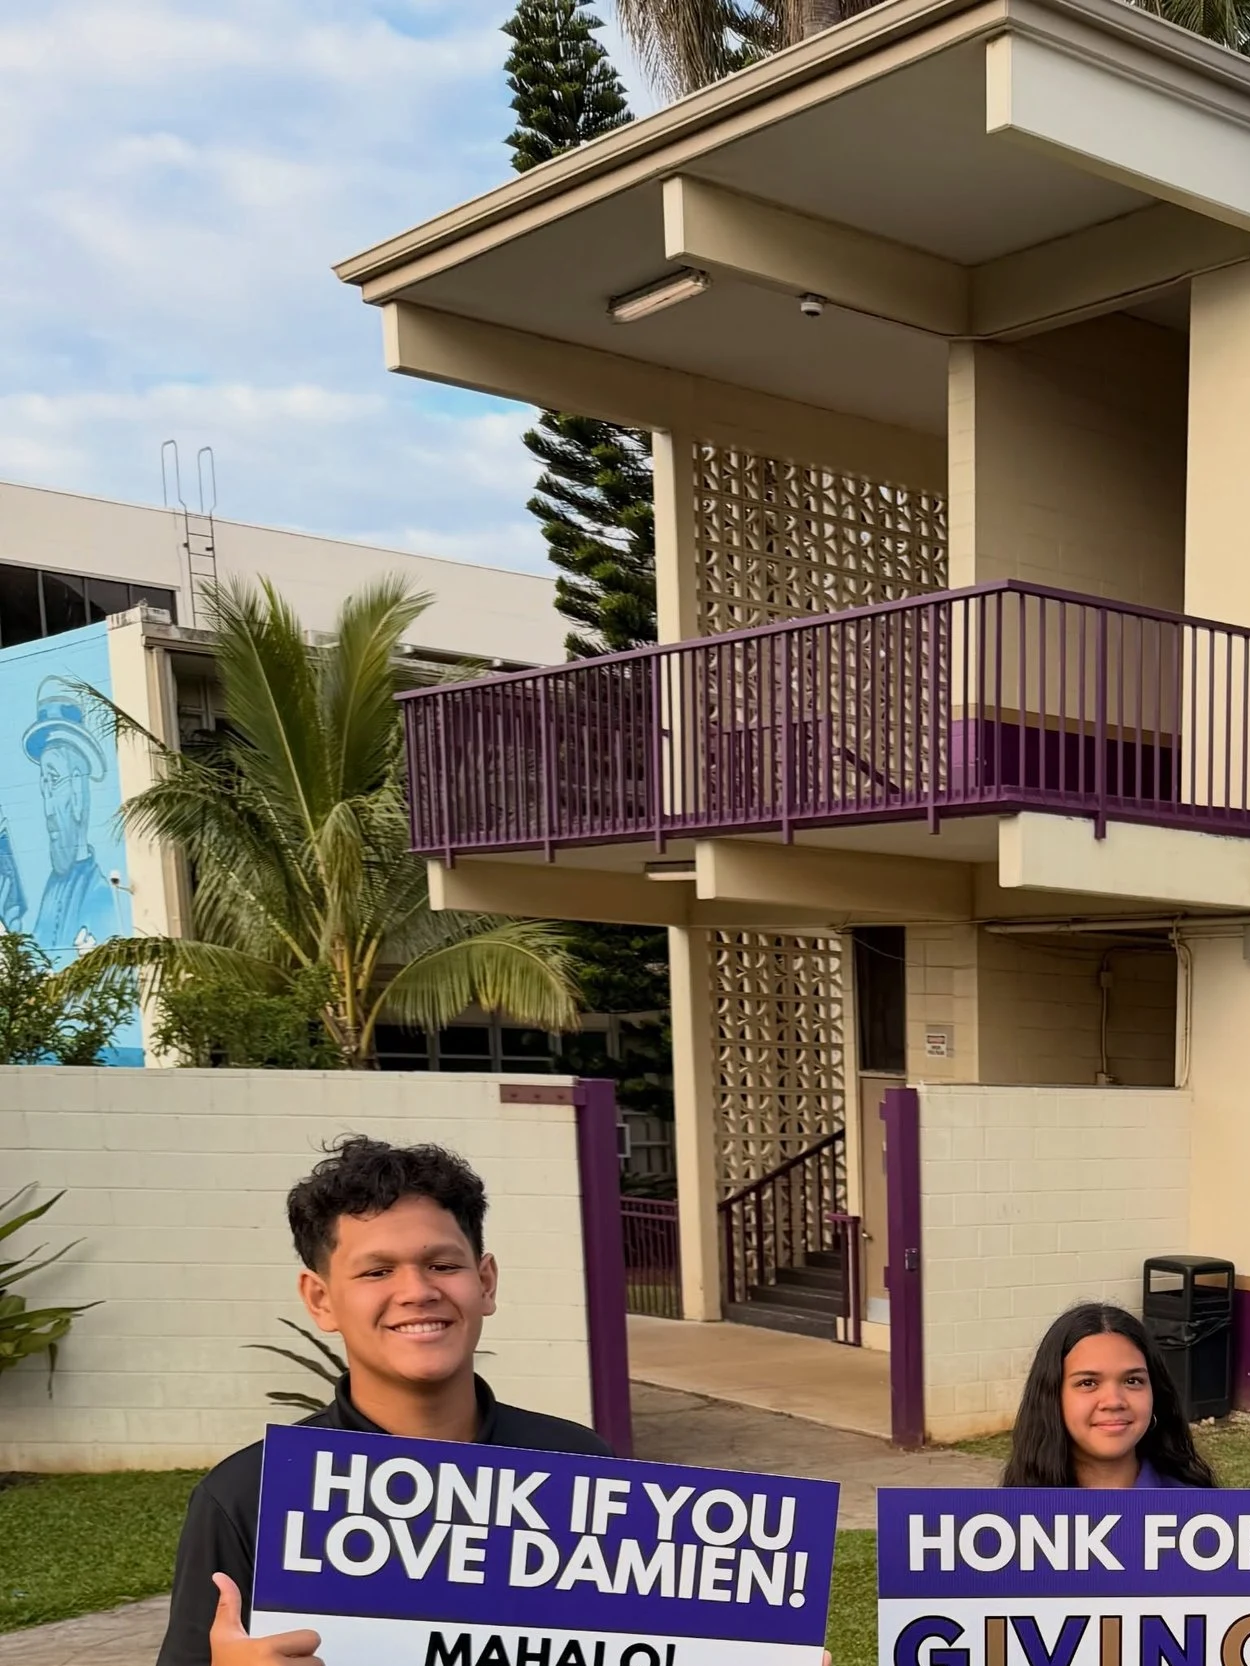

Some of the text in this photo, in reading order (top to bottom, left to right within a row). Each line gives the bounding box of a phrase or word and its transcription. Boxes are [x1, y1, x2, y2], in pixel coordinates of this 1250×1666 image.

[312, 1450, 797, 1552] HONK IF YOU
[908, 1513, 1126, 1572] HONK
[282, 1510, 810, 1609] LOVE DAMIEN!
